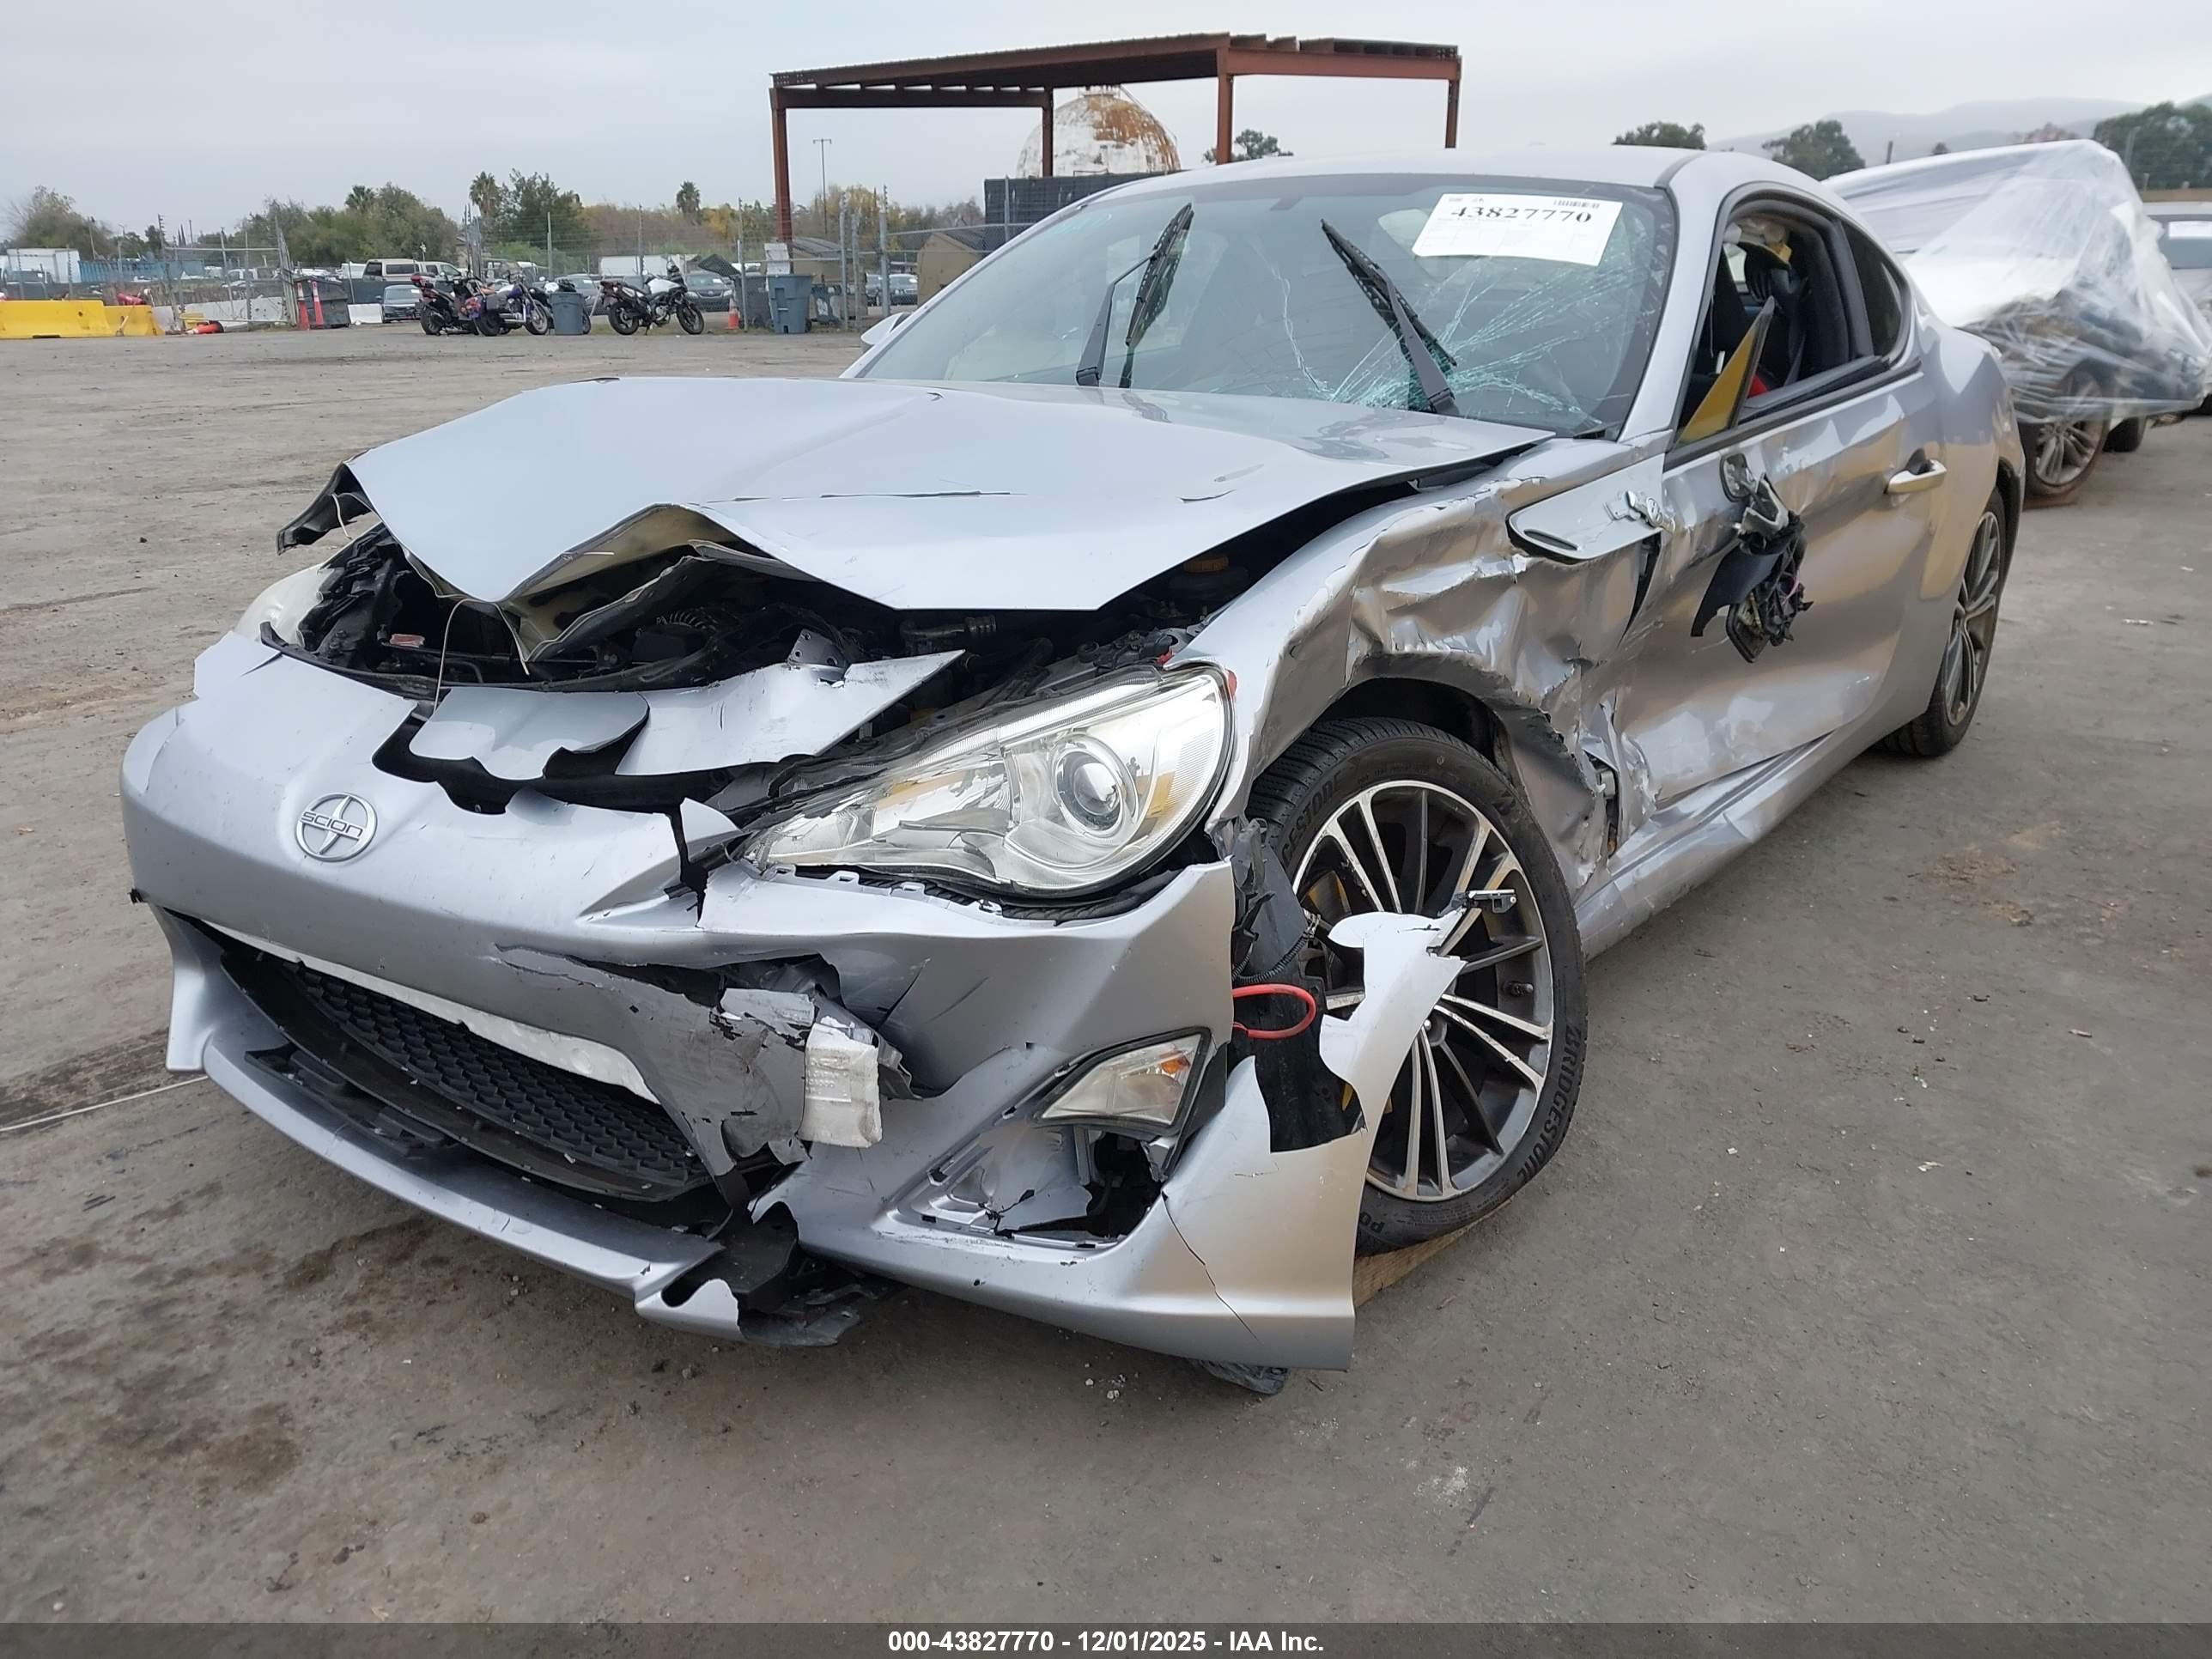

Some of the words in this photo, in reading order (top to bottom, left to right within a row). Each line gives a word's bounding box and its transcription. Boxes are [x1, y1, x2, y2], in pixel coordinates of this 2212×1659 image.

[1450, 205, 1592, 223] 43827770
[301, 811, 363, 837] SCION
[1281, 769, 1342, 867] GESTONE
[1516, 1022, 1582, 1181] BRIDGESTONE
